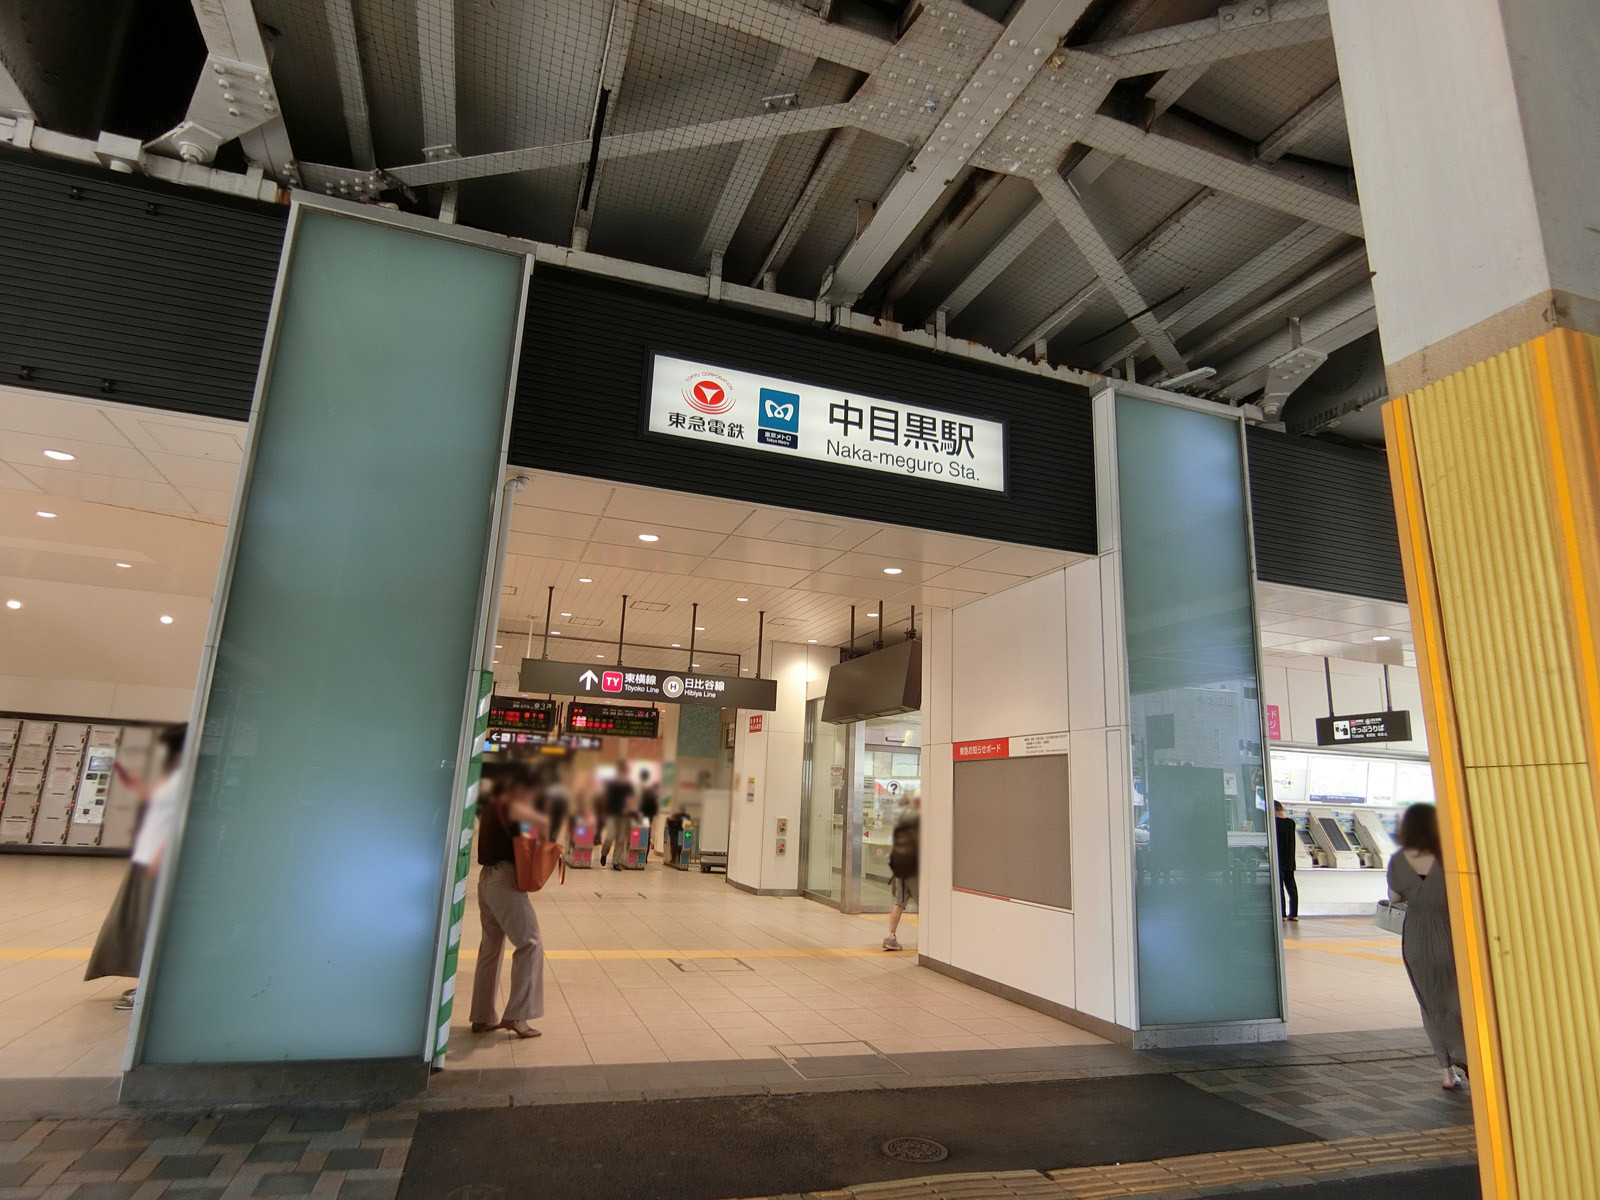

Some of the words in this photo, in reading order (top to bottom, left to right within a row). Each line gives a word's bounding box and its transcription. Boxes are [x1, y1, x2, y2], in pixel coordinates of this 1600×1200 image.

[685, 373, 700, 383] TOKYU
[702, 372, 733, 390] CORPORATION
[668, 411, 745, 440] 東急電鉄
[829, 399, 975, 459] 中目黒駅
[764, 431, 791, 441] 東京メトロ
[826, 439, 943, 473] Naka-meguro
[949, 461, 980, 481] Sta.
[605, 677, 620, 687] TY
[624, 672, 657, 685] 東横線
[624, 684, 645, 693] Toyoko
[646, 686, 659, 694] Line
[669, 683, 677, 691] H
[684, 678, 725, 692] 日比谷線
[684, 690, 702, 698] Hibiya
[1351, 724, 1384, 733] きっぷうりば
